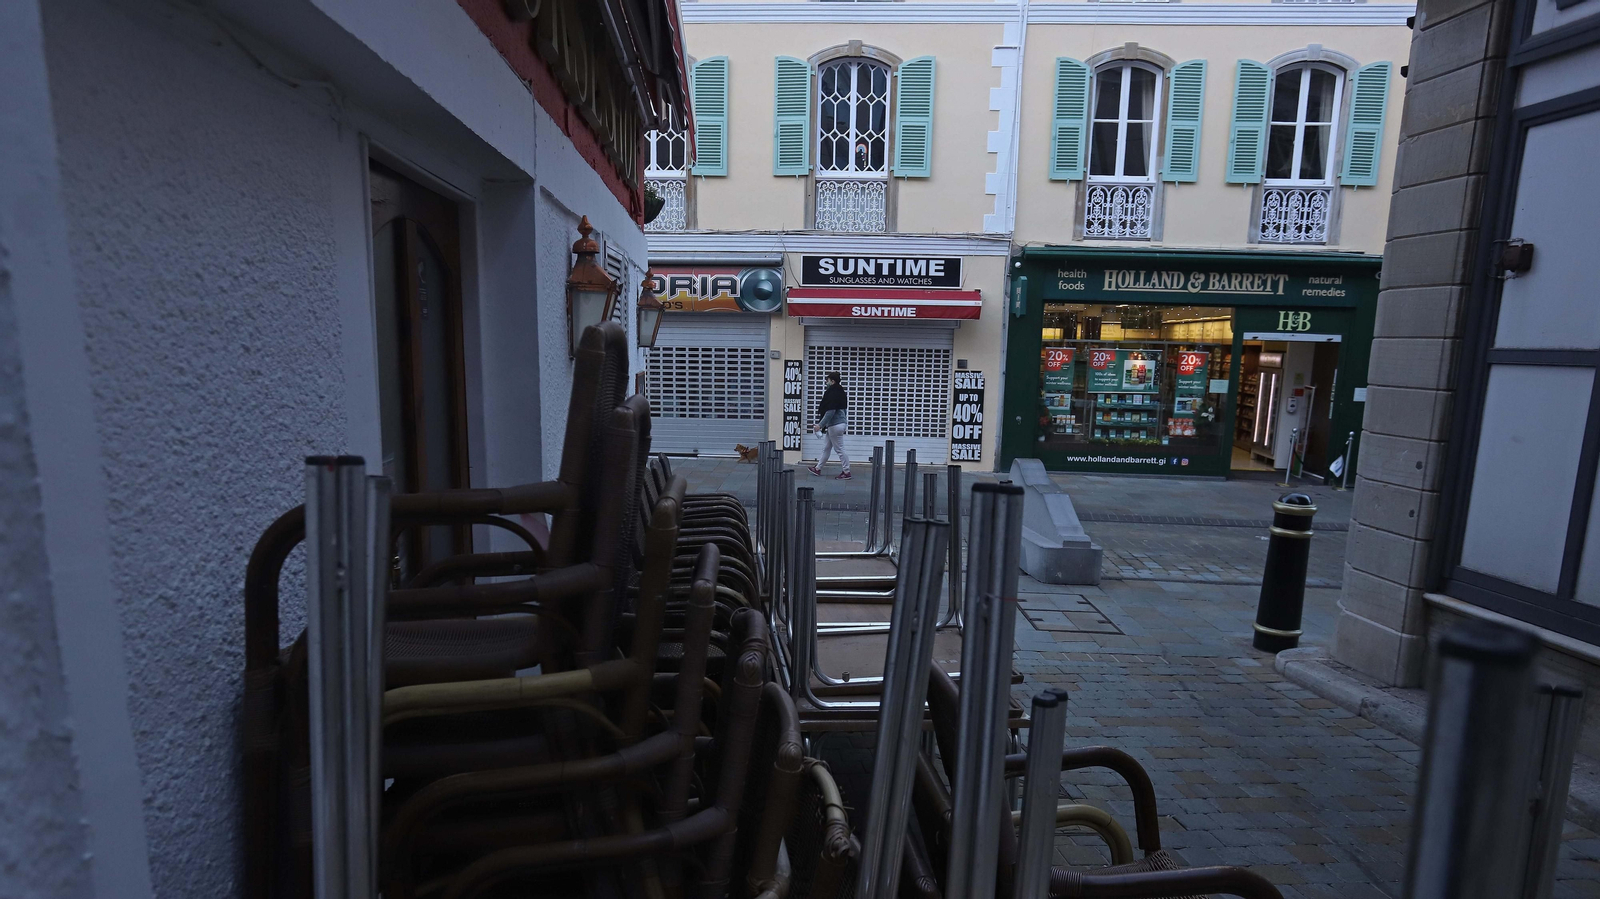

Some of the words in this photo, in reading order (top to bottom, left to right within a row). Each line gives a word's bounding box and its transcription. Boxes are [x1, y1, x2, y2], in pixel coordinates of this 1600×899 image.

[818, 258, 945, 277] SUNTIME
[1057, 269, 1087, 279] health
[1308, 275, 1343, 285] natural
[829, 276, 876, 284] SUNGLASSES
[896, 277, 932, 286] WATCHES
[1058, 281, 1085, 291] foods
[1102, 269, 1185, 291] HOLLAND
[1187, 271, 1206, 294] &
[1207, 272, 1289, 295] BARRETT
[1302, 287, 1346, 298] remedies
[851, 306, 917, 318] SUNTIME
[1276, 310, 1312, 332] H&B
[1048, 350, 1069, 361] 20%
[1093, 352, 1110, 360] 20%
[1181, 354, 1202, 365] 20%
[785, 367, 802, 381] 40%
[784, 381, 802, 395] OFF
[954, 378, 984, 390] SALE
[959, 393, 968, 402] UP
[969, 393, 978, 402] TO
[784, 403, 801, 413] SALE
[953, 403, 983, 423] 40%
[783, 421, 801, 435] 40%
[952, 424, 983, 440] OFF
[783, 435, 801, 449] OFF
[951, 449, 981, 461] SALE
[1066, 455, 1167, 466] www.hollandandbarrett.gi
